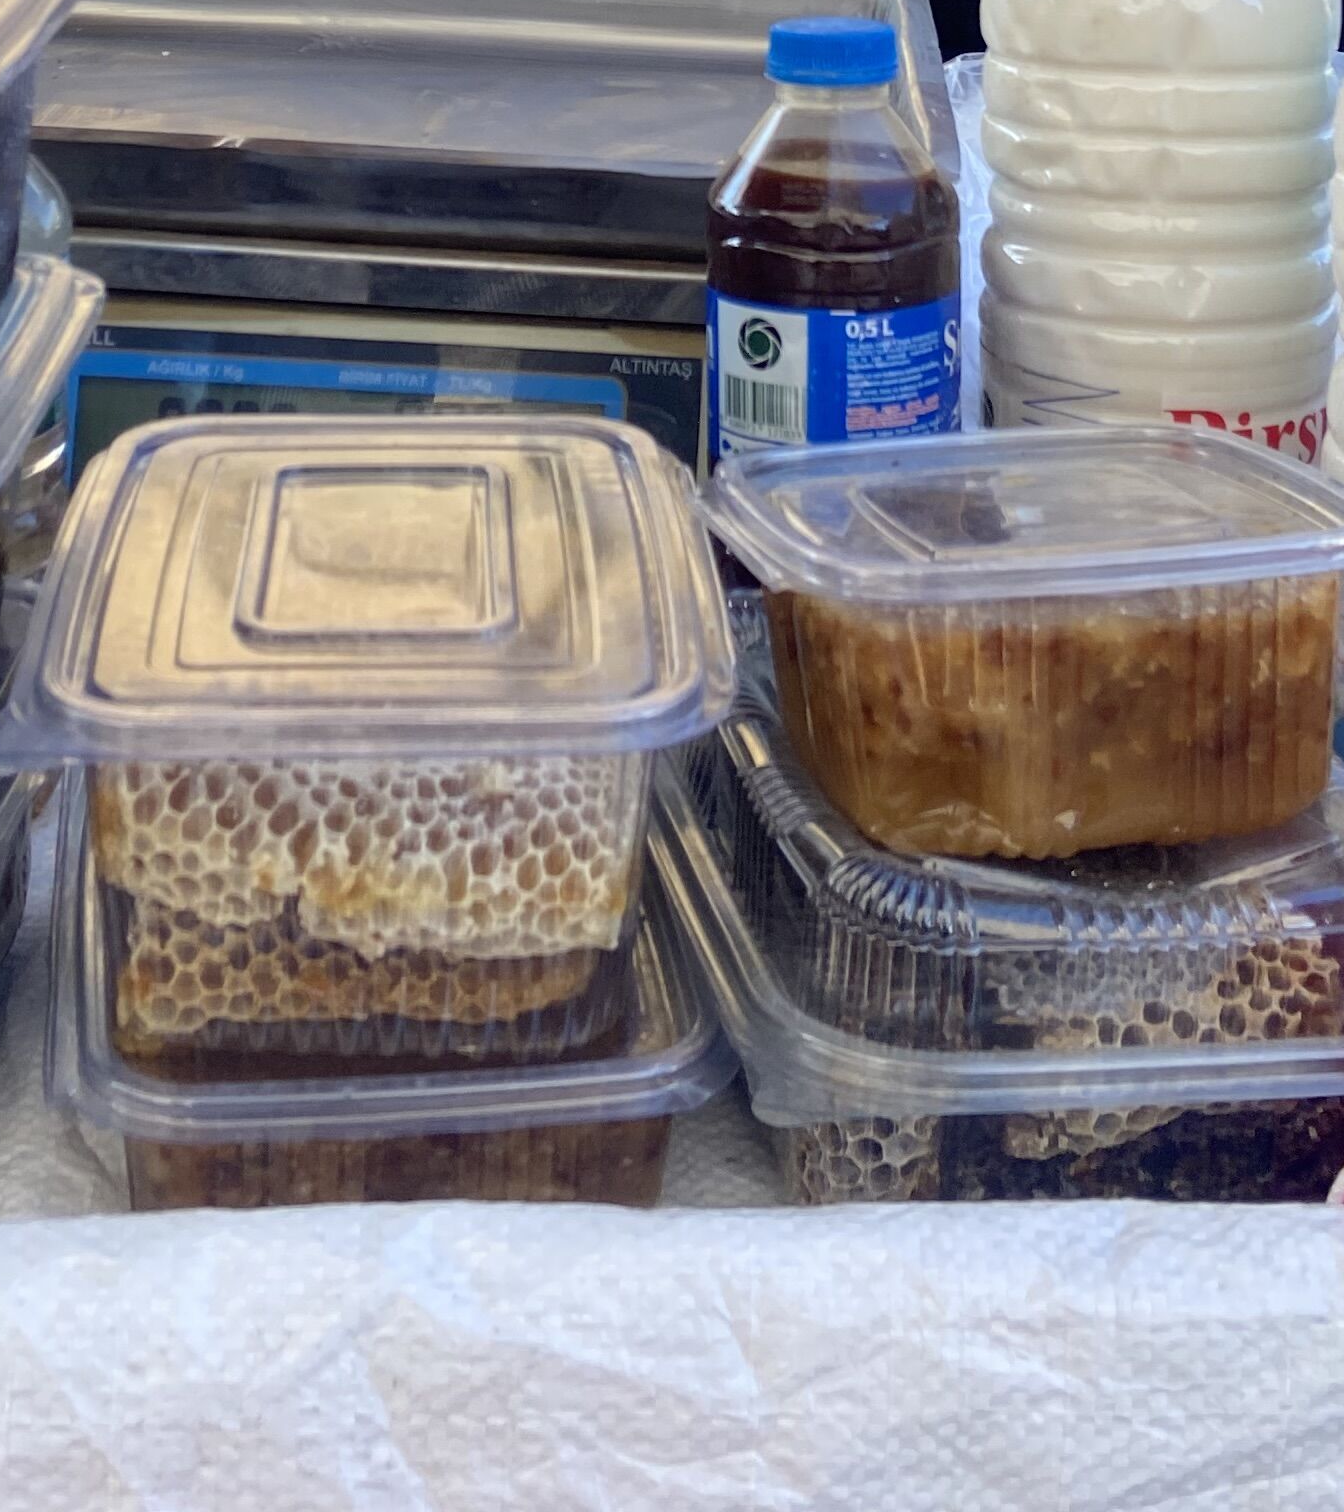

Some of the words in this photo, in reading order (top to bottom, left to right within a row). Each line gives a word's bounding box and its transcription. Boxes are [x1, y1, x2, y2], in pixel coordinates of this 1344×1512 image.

[845, 320, 878, 344] 0,5
[882, 319, 895, 337] L
[610, 357, 693, 380] ALTINTAŞ
